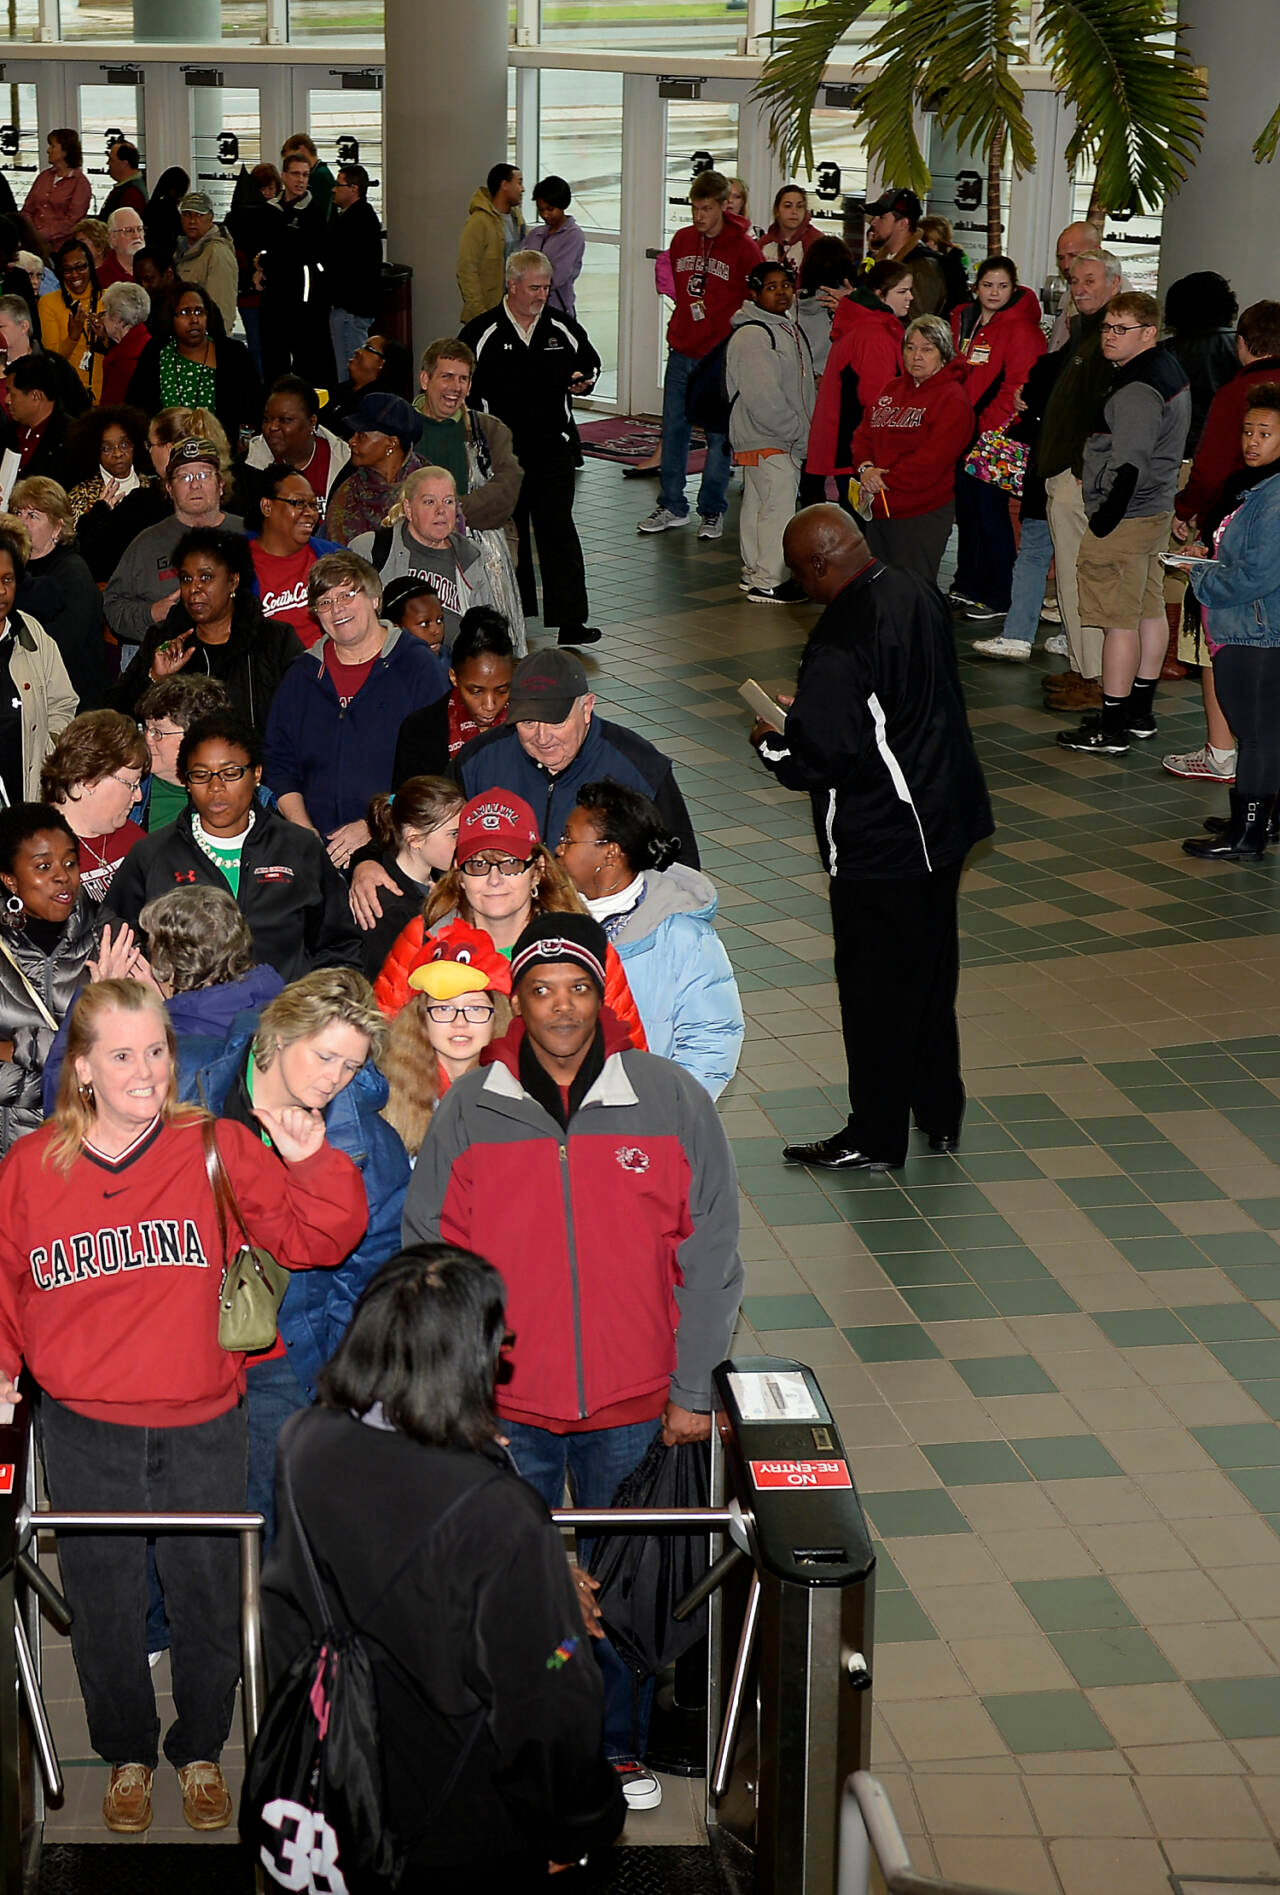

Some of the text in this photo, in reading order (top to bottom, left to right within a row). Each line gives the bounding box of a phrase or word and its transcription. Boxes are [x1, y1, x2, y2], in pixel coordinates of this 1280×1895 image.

[30, 1219, 209, 1292] CAROLINA
[760, 1463, 839, 1473] RE-ENTRY
[787, 1474, 817, 1485] NO
